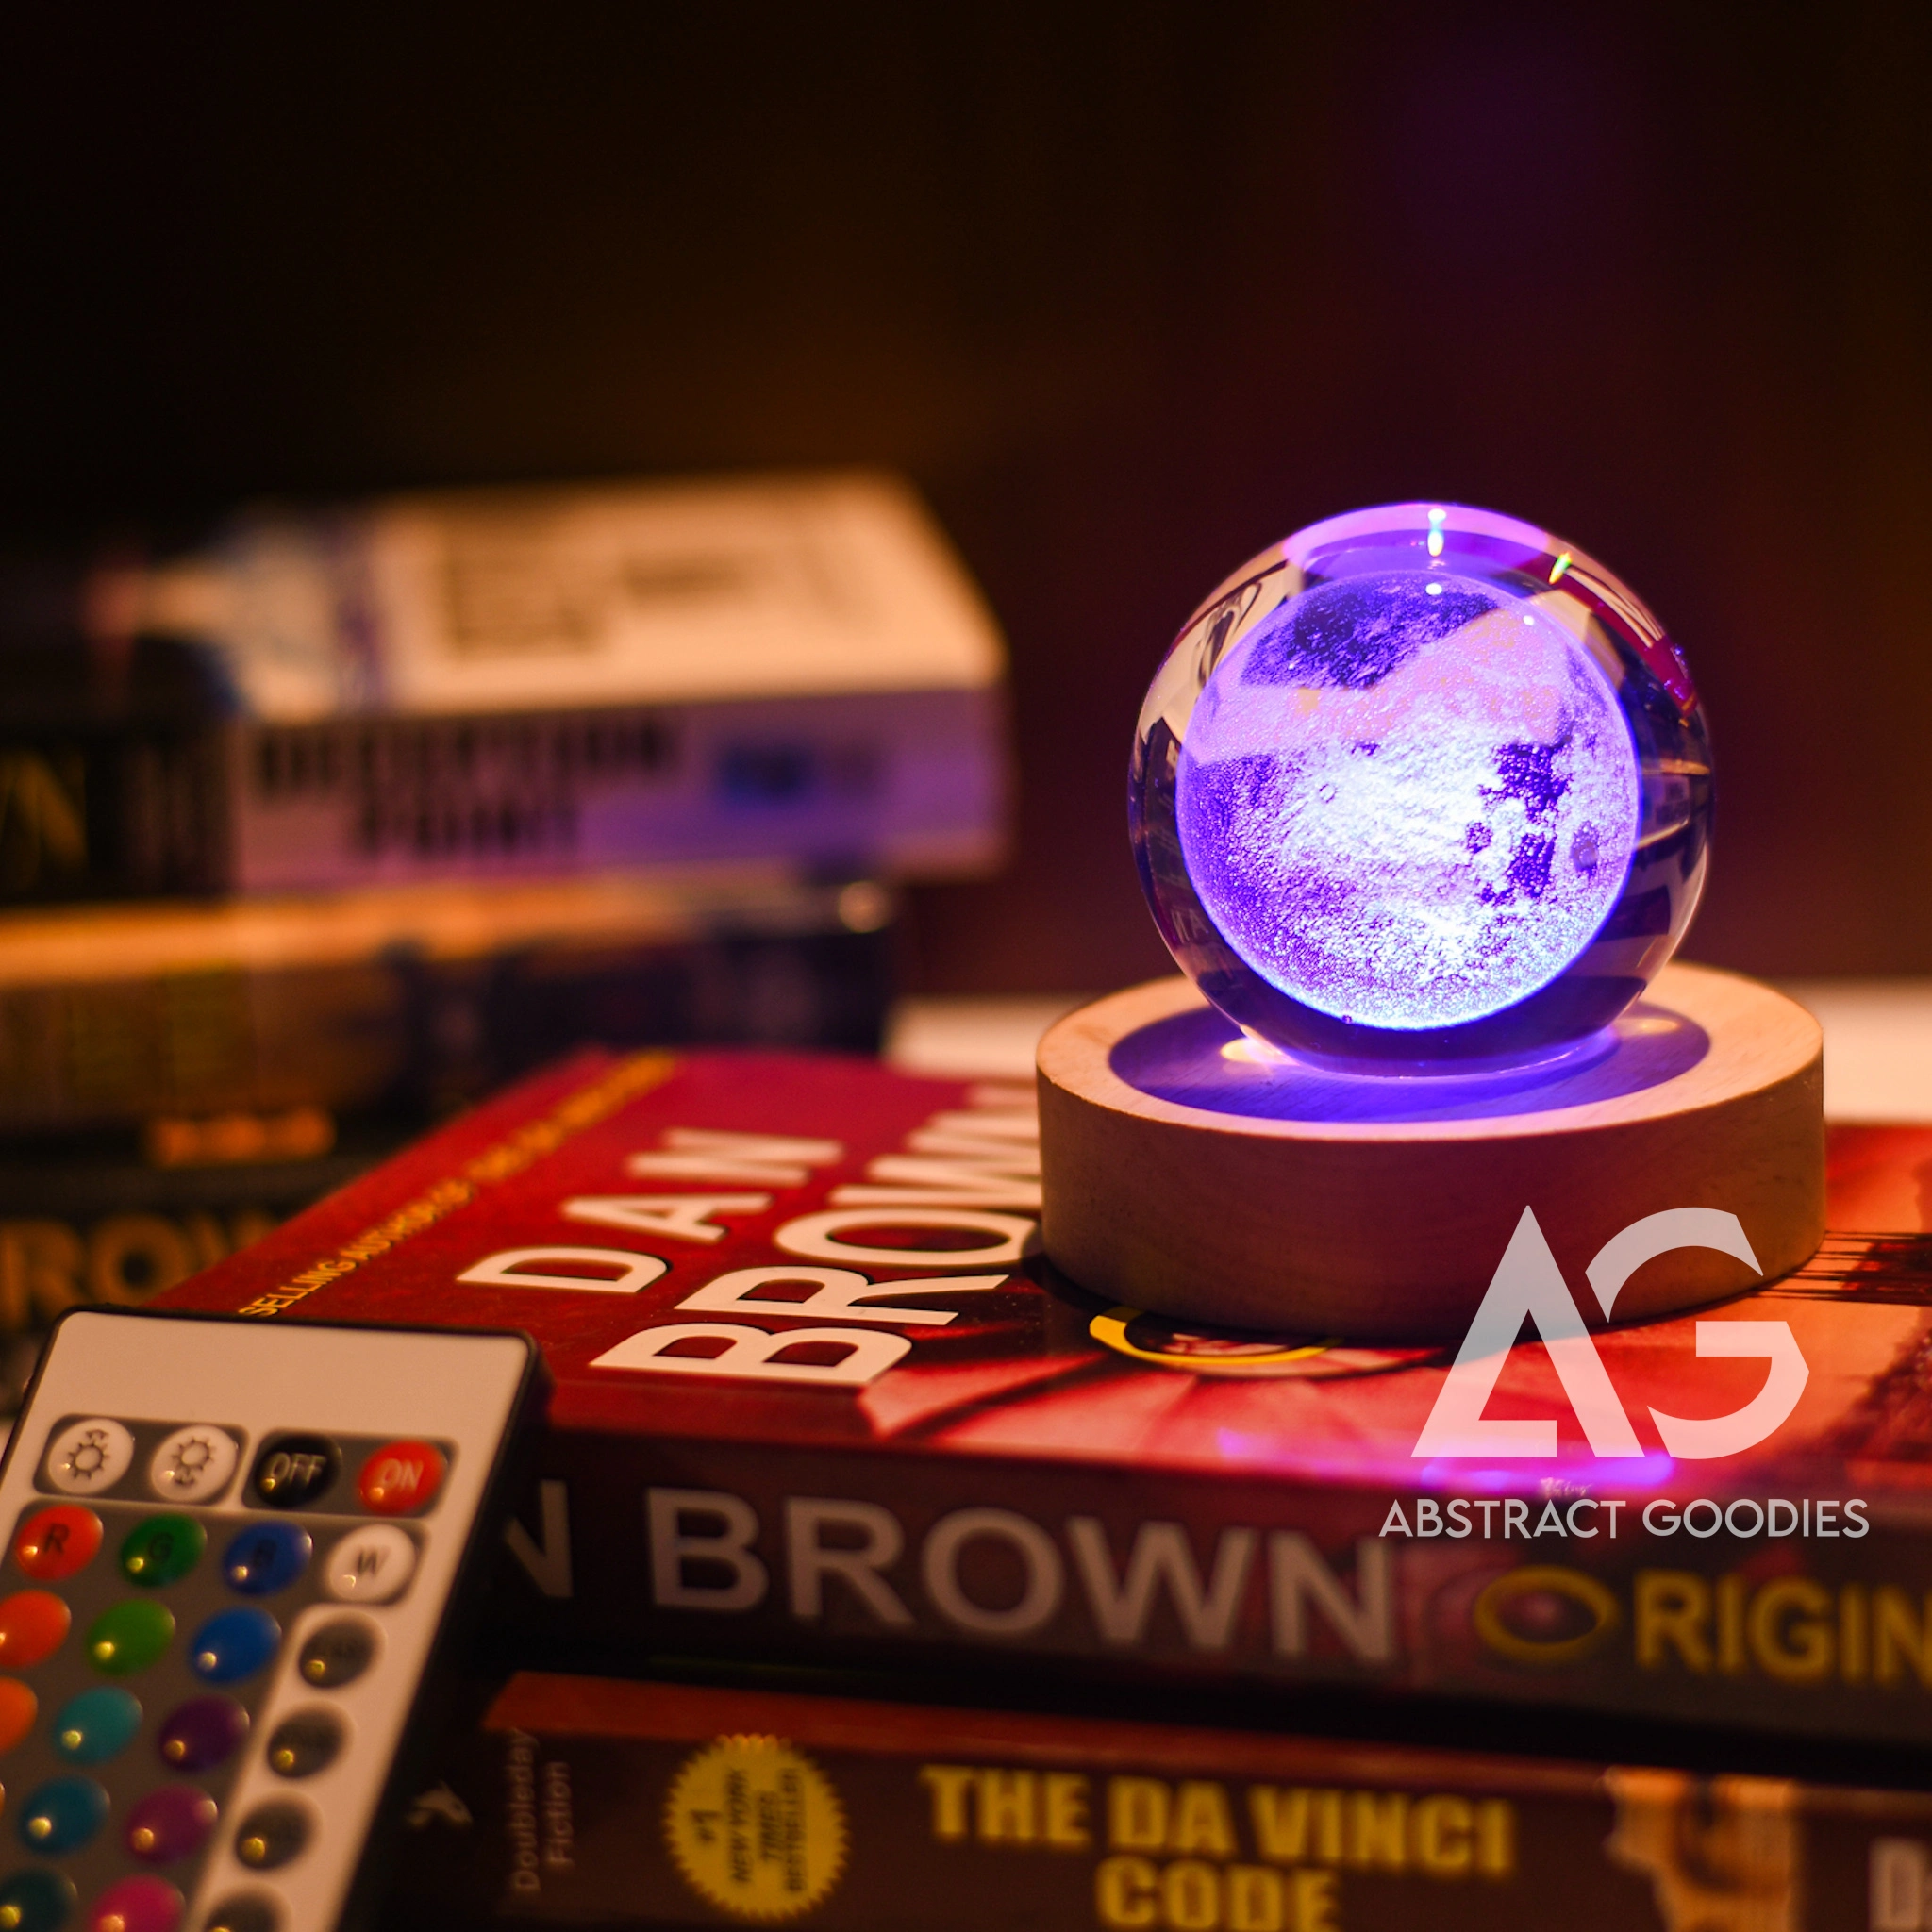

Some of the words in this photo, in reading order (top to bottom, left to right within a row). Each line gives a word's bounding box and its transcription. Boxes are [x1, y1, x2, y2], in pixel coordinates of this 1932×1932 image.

[456, 1129, 841, 1292] DAN
[239, 1260, 357, 1317] SELLING
[266, 1451, 327, 1488] OFF
[377, 1457, 425, 1495] ON
[44, 1523, 70, 1553] R
[148, 1532, 174, 1563] G
[356, 1545, 392, 1575] W
[645, 1486, 1400, 1665] BROWN
[506, 1727, 541, 1892] Doubleday
[543, 1761, 575, 1868] Fiction
[920, 1766, 1090, 1847] THE
[1108, 1776, 1235, 1856] DA
[1249, 1783, 1515, 1875] VINCI
[1095, 1857, 1339, 1932] CODE
